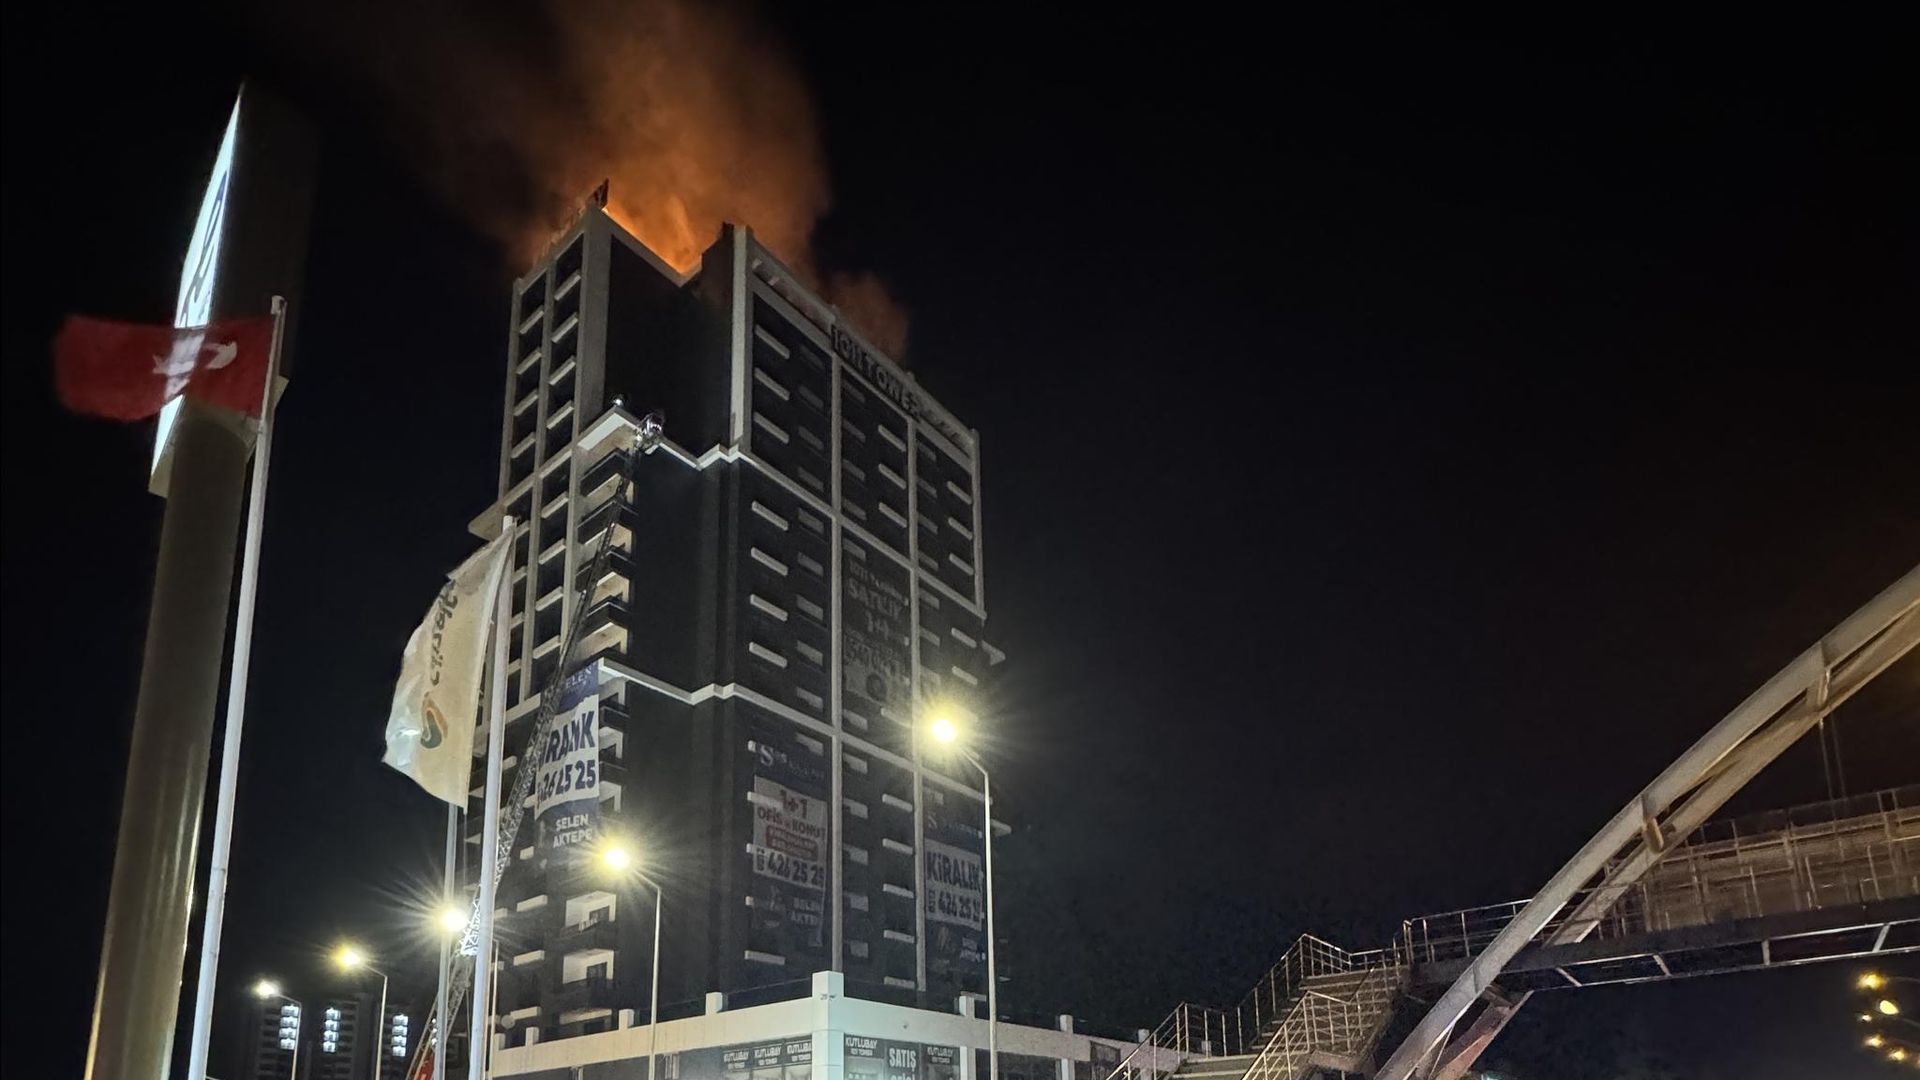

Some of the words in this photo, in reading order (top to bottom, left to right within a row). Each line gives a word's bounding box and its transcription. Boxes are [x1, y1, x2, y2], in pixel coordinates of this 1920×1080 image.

[575, 760, 596, 791] 25
[555, 813, 590, 832] SELEN
[552, 829, 594, 849] AKTEPE
[768, 851, 790, 878] 426
[793, 860, 808, 883] 25
[845, 1037, 877, 1049] KUTLUBAY
[889, 1047, 916, 1072] SATIŞ
